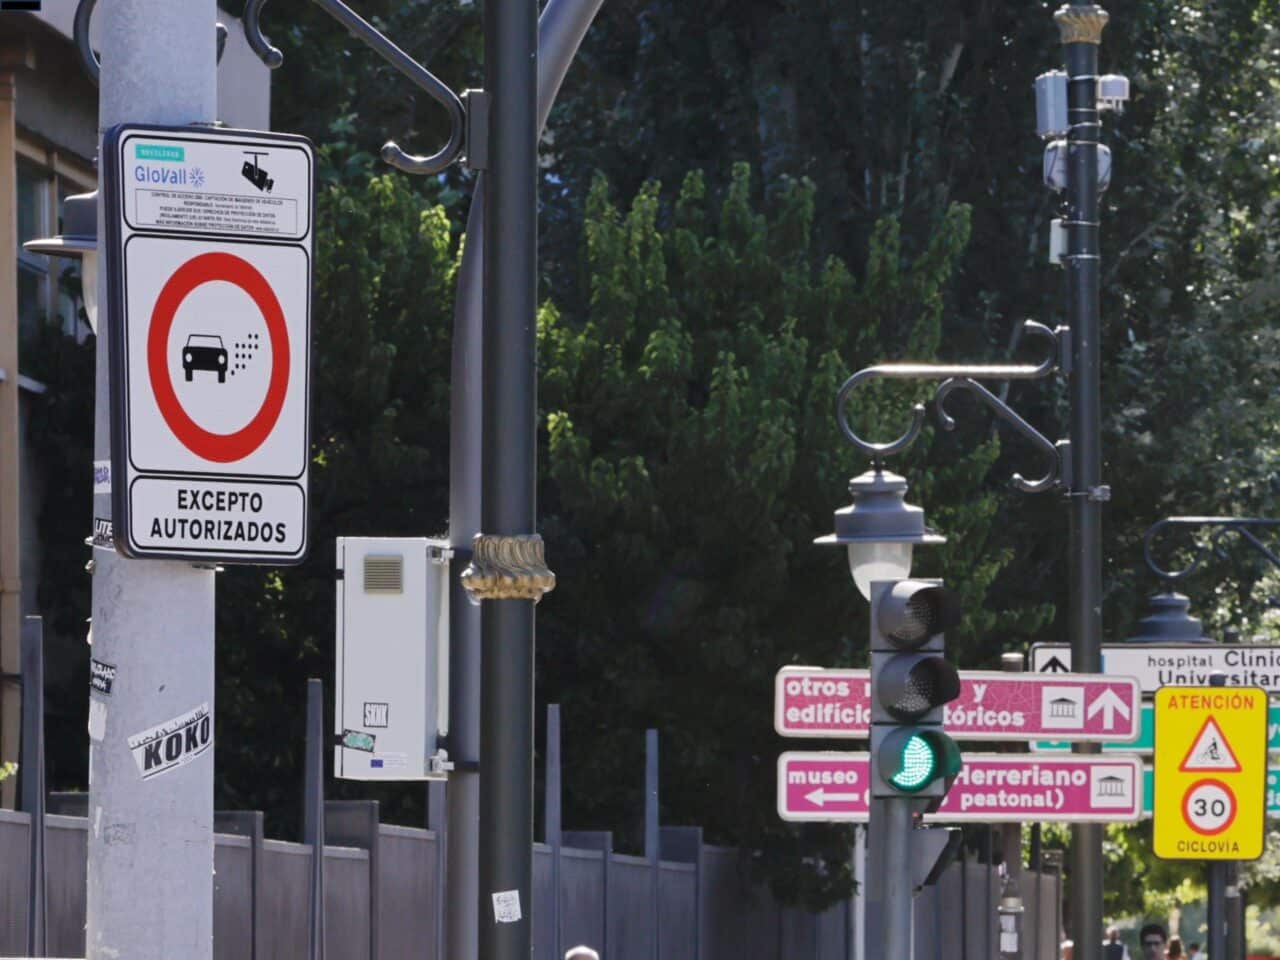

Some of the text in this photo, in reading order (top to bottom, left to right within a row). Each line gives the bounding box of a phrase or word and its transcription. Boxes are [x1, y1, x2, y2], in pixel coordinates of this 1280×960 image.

[177, 489, 263, 513] EXCEPTO
[151, 517, 287, 543] AUTORIZADOS
[1147, 655, 1213, 669] hospital
[786, 678, 850, 697] otros
[972, 683, 988, 704] y
[1168, 691, 1255, 710] ATENCIÓN
[944, 704, 1025, 727] tóricos
[144, 715, 210, 771] KOKO
[788, 769, 859, 785] museo
[954, 764, 1087, 787] Herreriano
[960, 787, 1065, 811] peatonal)
[1193, 798, 1226, 818] 30
